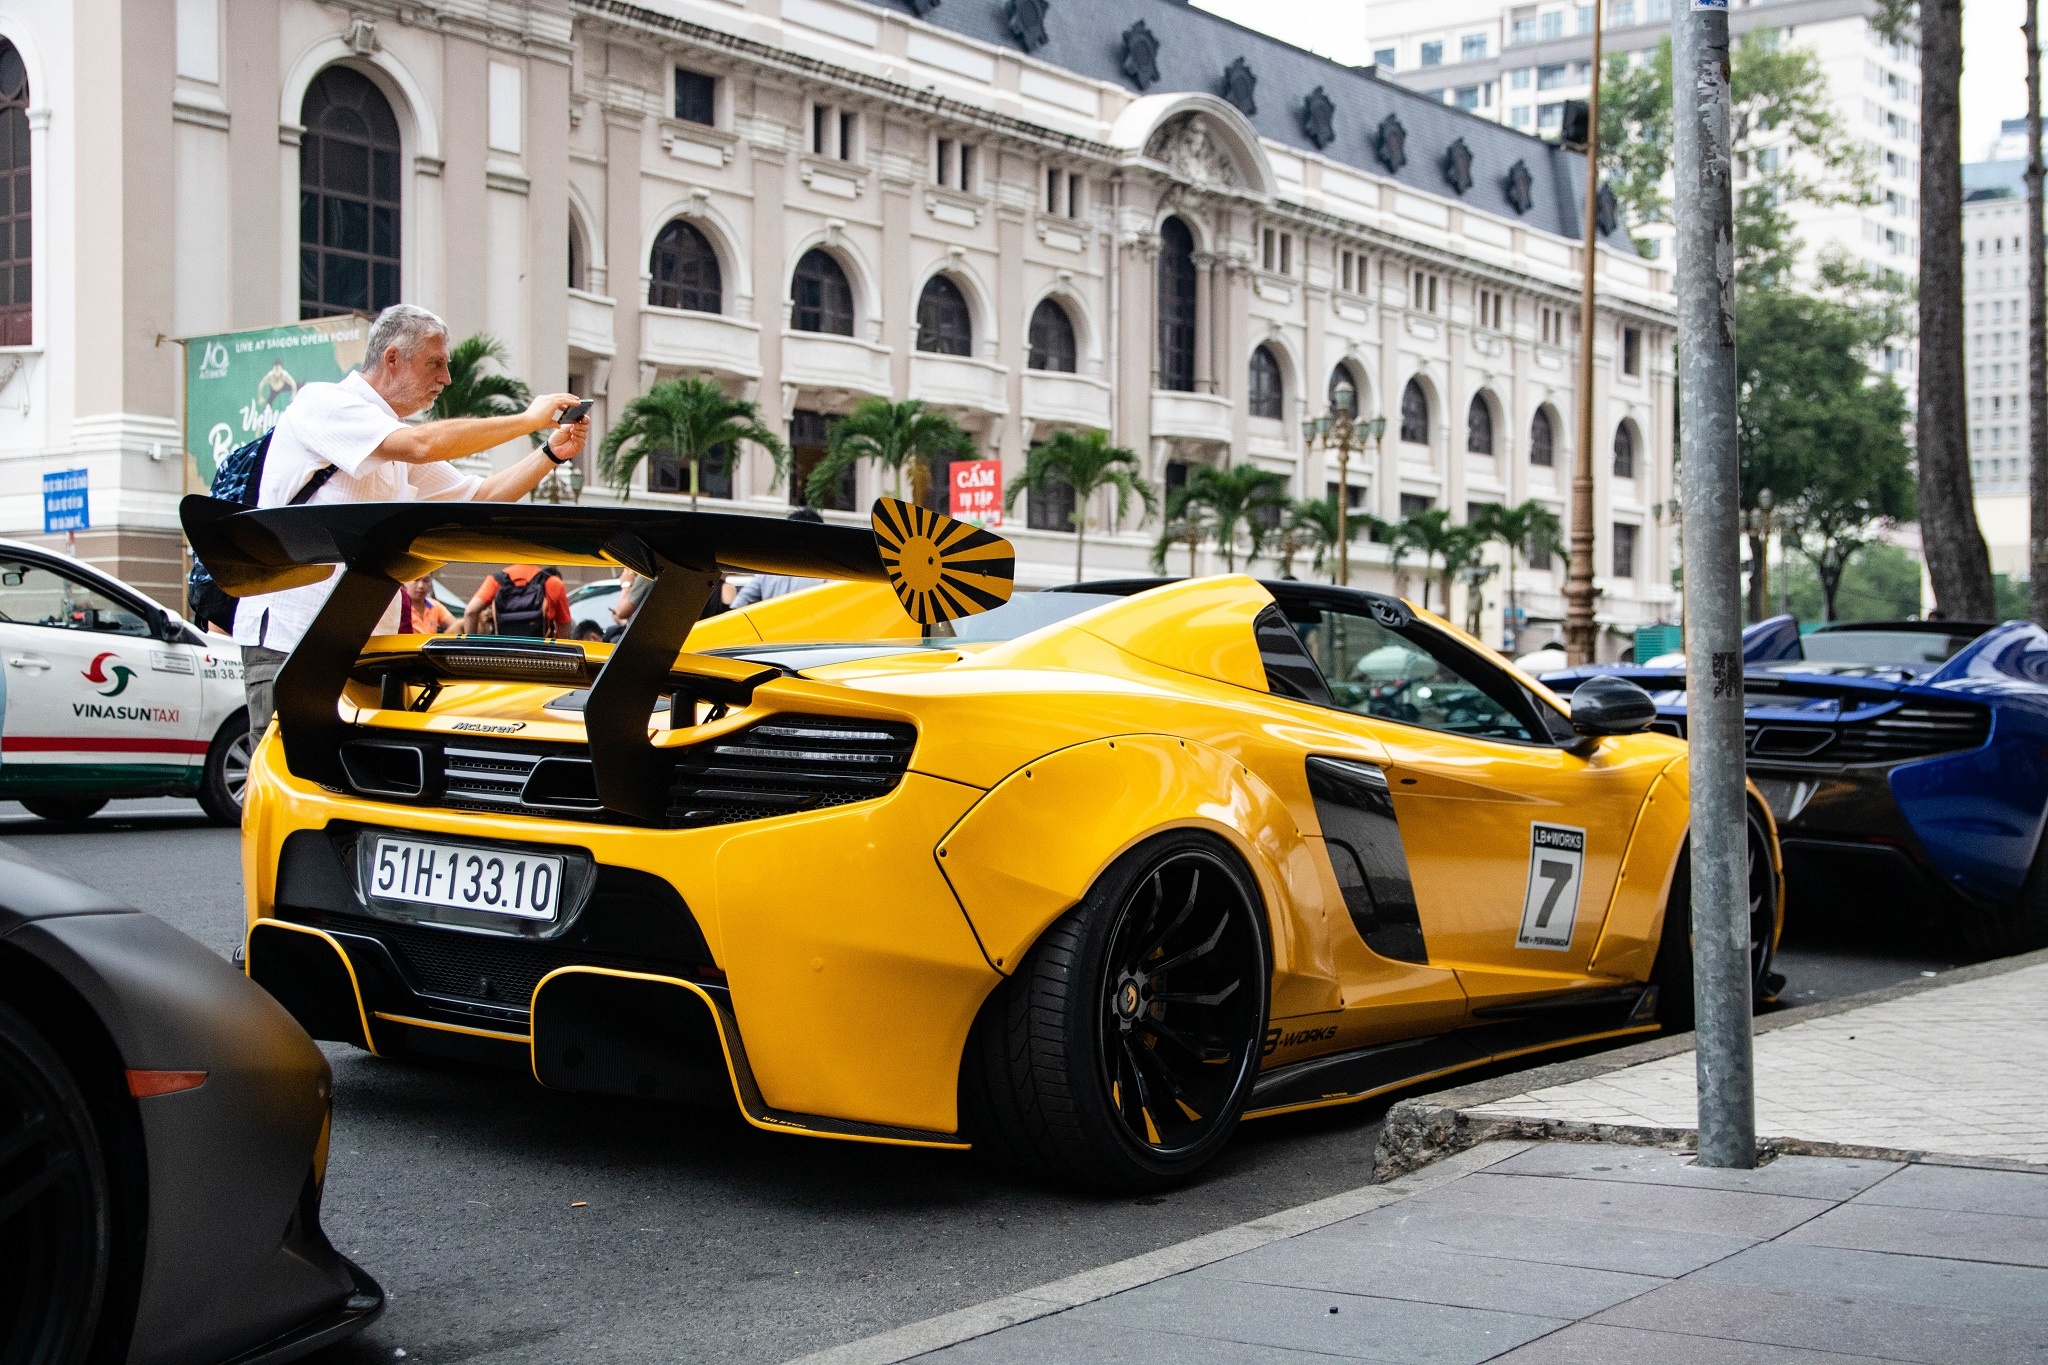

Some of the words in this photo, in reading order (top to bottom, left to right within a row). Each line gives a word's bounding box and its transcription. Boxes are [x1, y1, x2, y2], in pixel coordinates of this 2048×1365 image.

[235, 342, 253, 353] LIVE
[255, 340, 265, 350] AT
[267, 336, 299, 349] SAIGON
[301, 334, 329, 346] OPERA
[957, 463, 995, 488] CẤM
[451, 722, 516, 733] McLaren
[378, 844, 552, 912] 51H-133.10
[1535, 860, 1573, 928] 7
